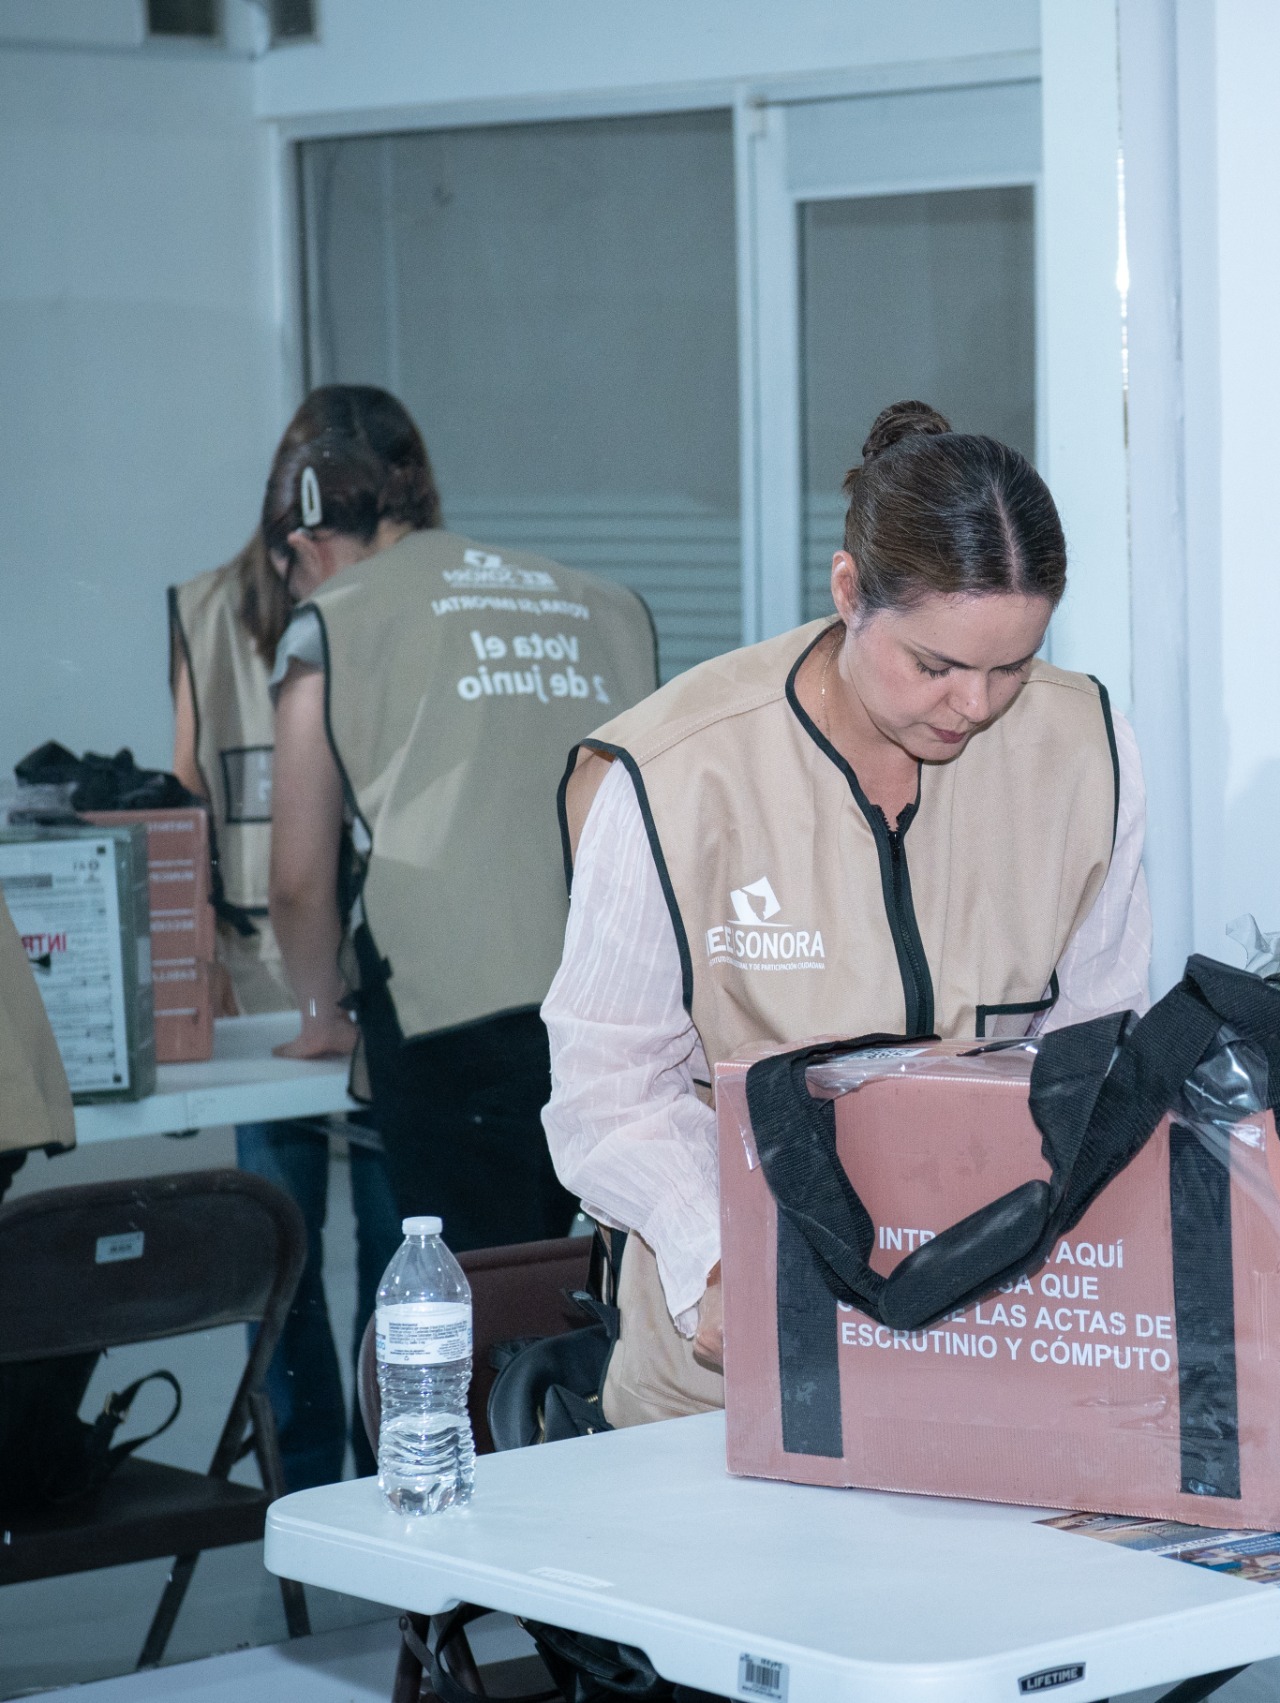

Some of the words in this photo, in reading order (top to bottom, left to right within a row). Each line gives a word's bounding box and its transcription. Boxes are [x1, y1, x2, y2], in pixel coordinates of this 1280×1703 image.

[735, 930, 826, 959] SONORA
[1056, 1238, 1125, 1269] AQUÍ
[1040, 1273, 1100, 1300] QUE
[975, 1302, 1028, 1329] LAS
[1034, 1305, 1127, 1336] ACTAS
[1135, 1313, 1173, 1340] DE
[841, 1321, 998, 1359] ESCRUTINIO
[1004, 1336, 1023, 1361] Y
[1030, 1335, 1172, 1373] CÓMPUTO
[1026, 1667, 1080, 1691] LIFETIME
